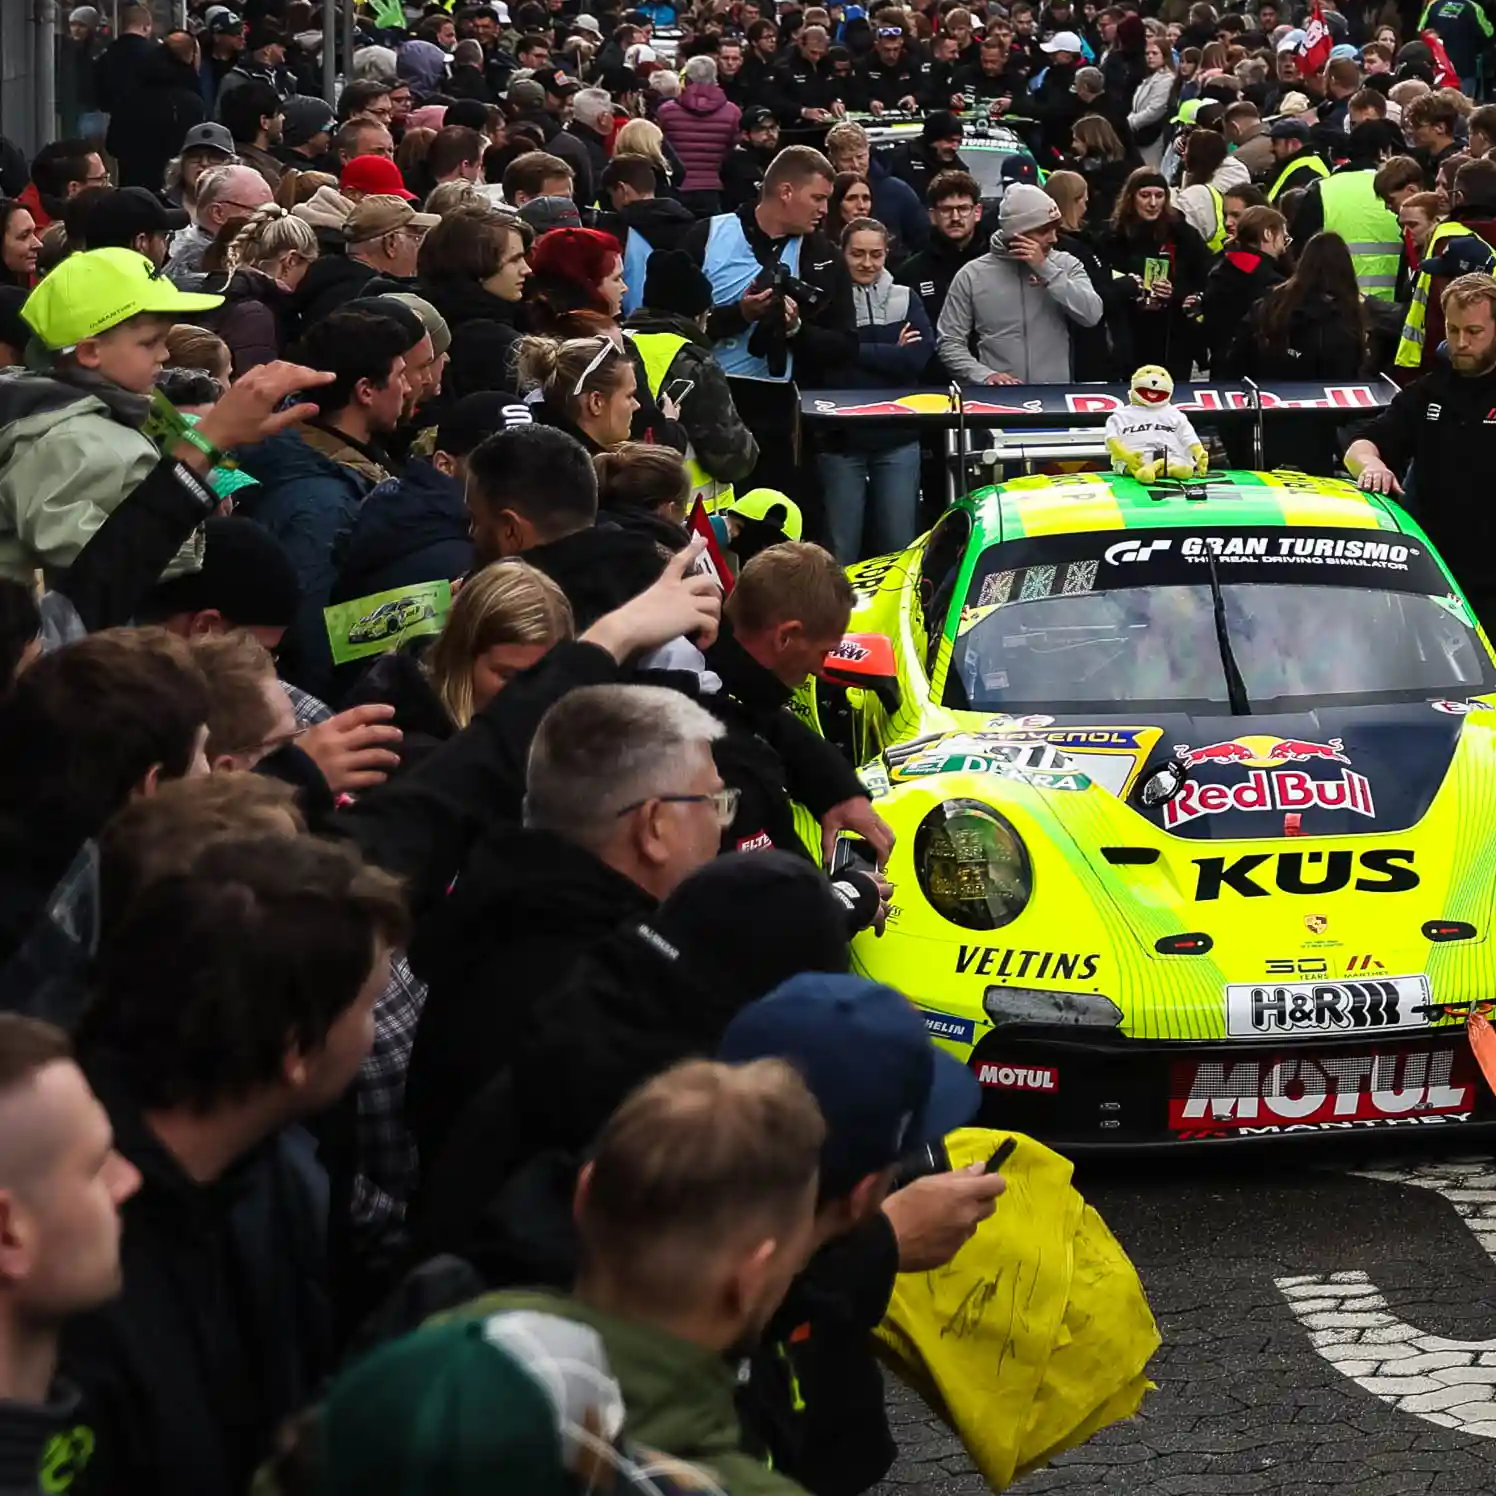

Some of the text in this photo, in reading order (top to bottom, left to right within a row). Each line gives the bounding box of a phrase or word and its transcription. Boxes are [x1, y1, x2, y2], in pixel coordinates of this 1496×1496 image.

[961, 138, 1018, 149] TURISMO
[1122, 423, 1152, 435] FLAT
[1181, 536, 1266, 557] GRAN
[1221, 555, 1257, 565] REAL
[1262, 556, 1322, 566] DRIVING
[1324, 557, 1409, 571] SIMULATOR
[1163, 767, 1376, 829] Red Bull
[1191, 848, 1421, 902] KÜS
[955, 944, 1100, 981] VELTINS
[1299, 973, 1330, 982] YEARS
[1344, 969, 1389, 980] MANTHEY
[1251, 985, 1352, 1032] H&R
[926, 1019, 966, 1036] HELIN
[978, 1064, 1055, 1088] MOTUL
[1181, 1049, 1467, 1120] MOTUL
[1238, 1111, 1472, 1136] MANTHEY
